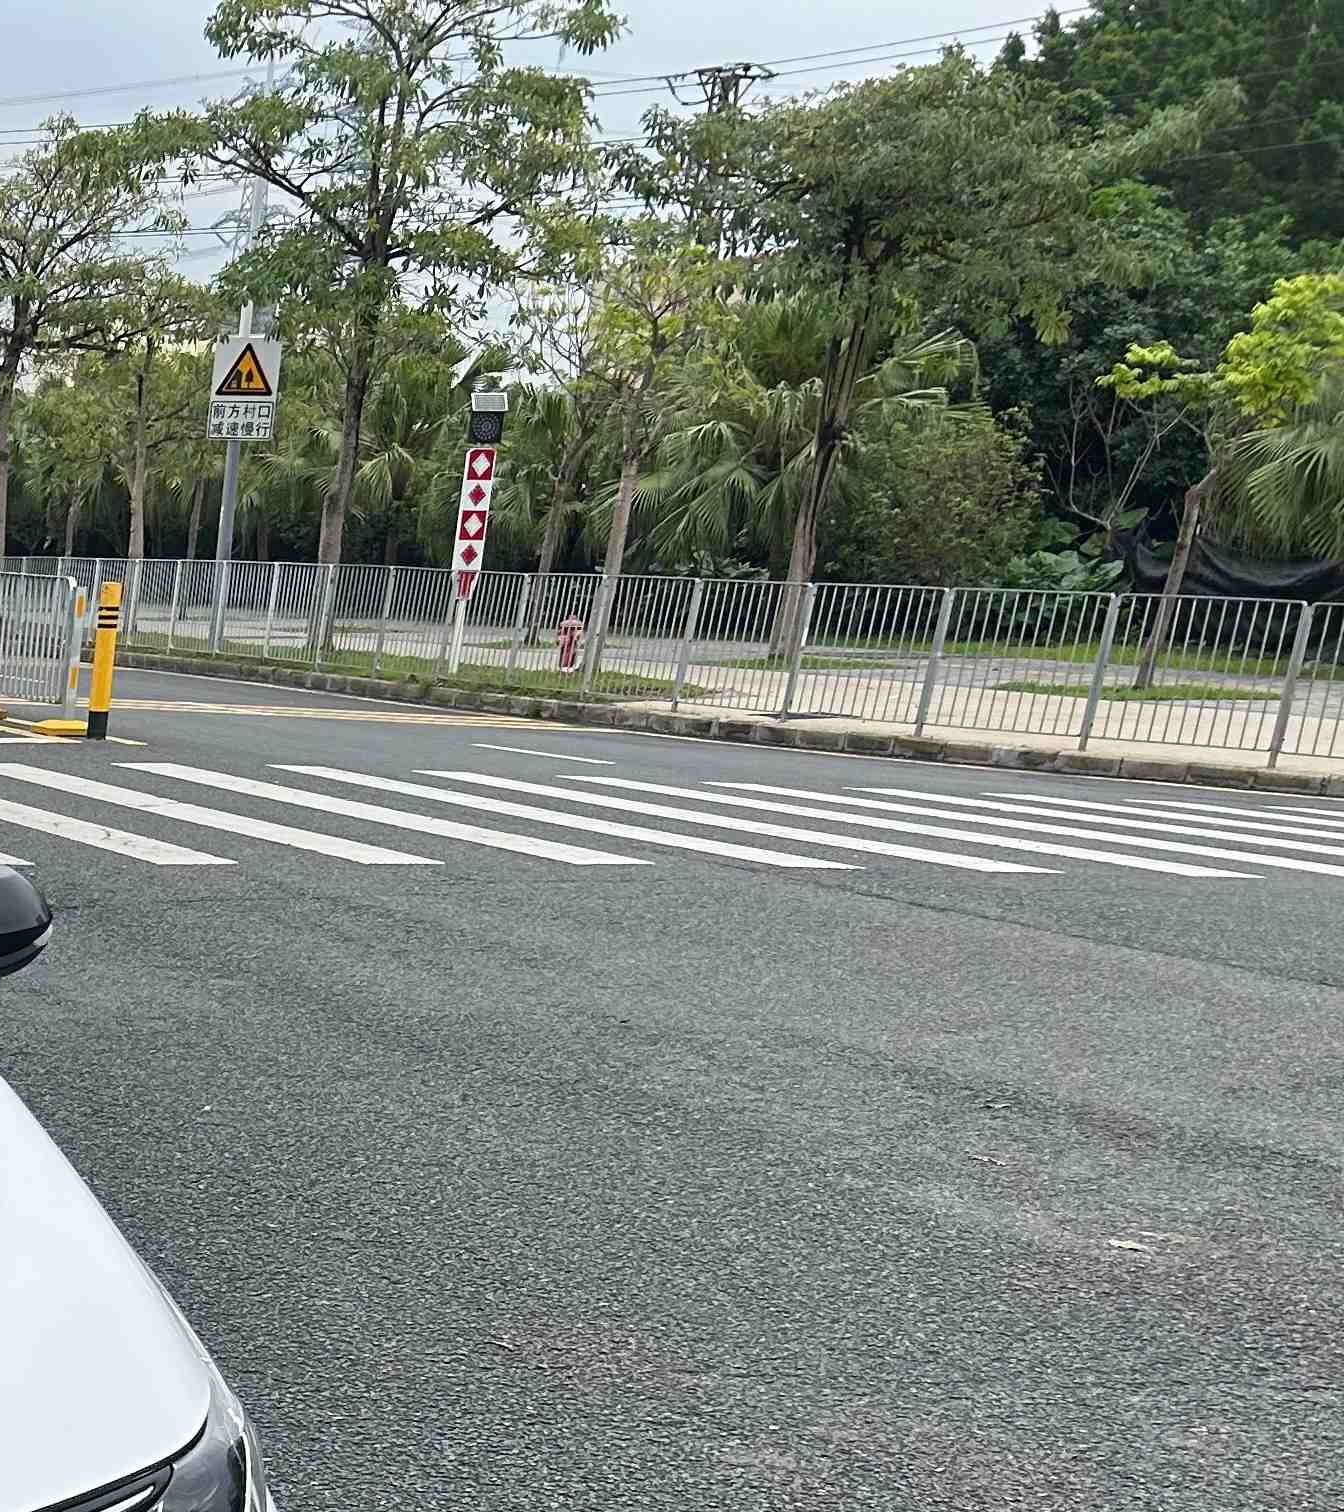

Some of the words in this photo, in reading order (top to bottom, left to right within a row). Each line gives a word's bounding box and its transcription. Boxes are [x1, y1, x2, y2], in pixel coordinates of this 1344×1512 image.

[212, 404, 271, 418] 前方村口
[211, 421, 270, 436] 减速慢行
